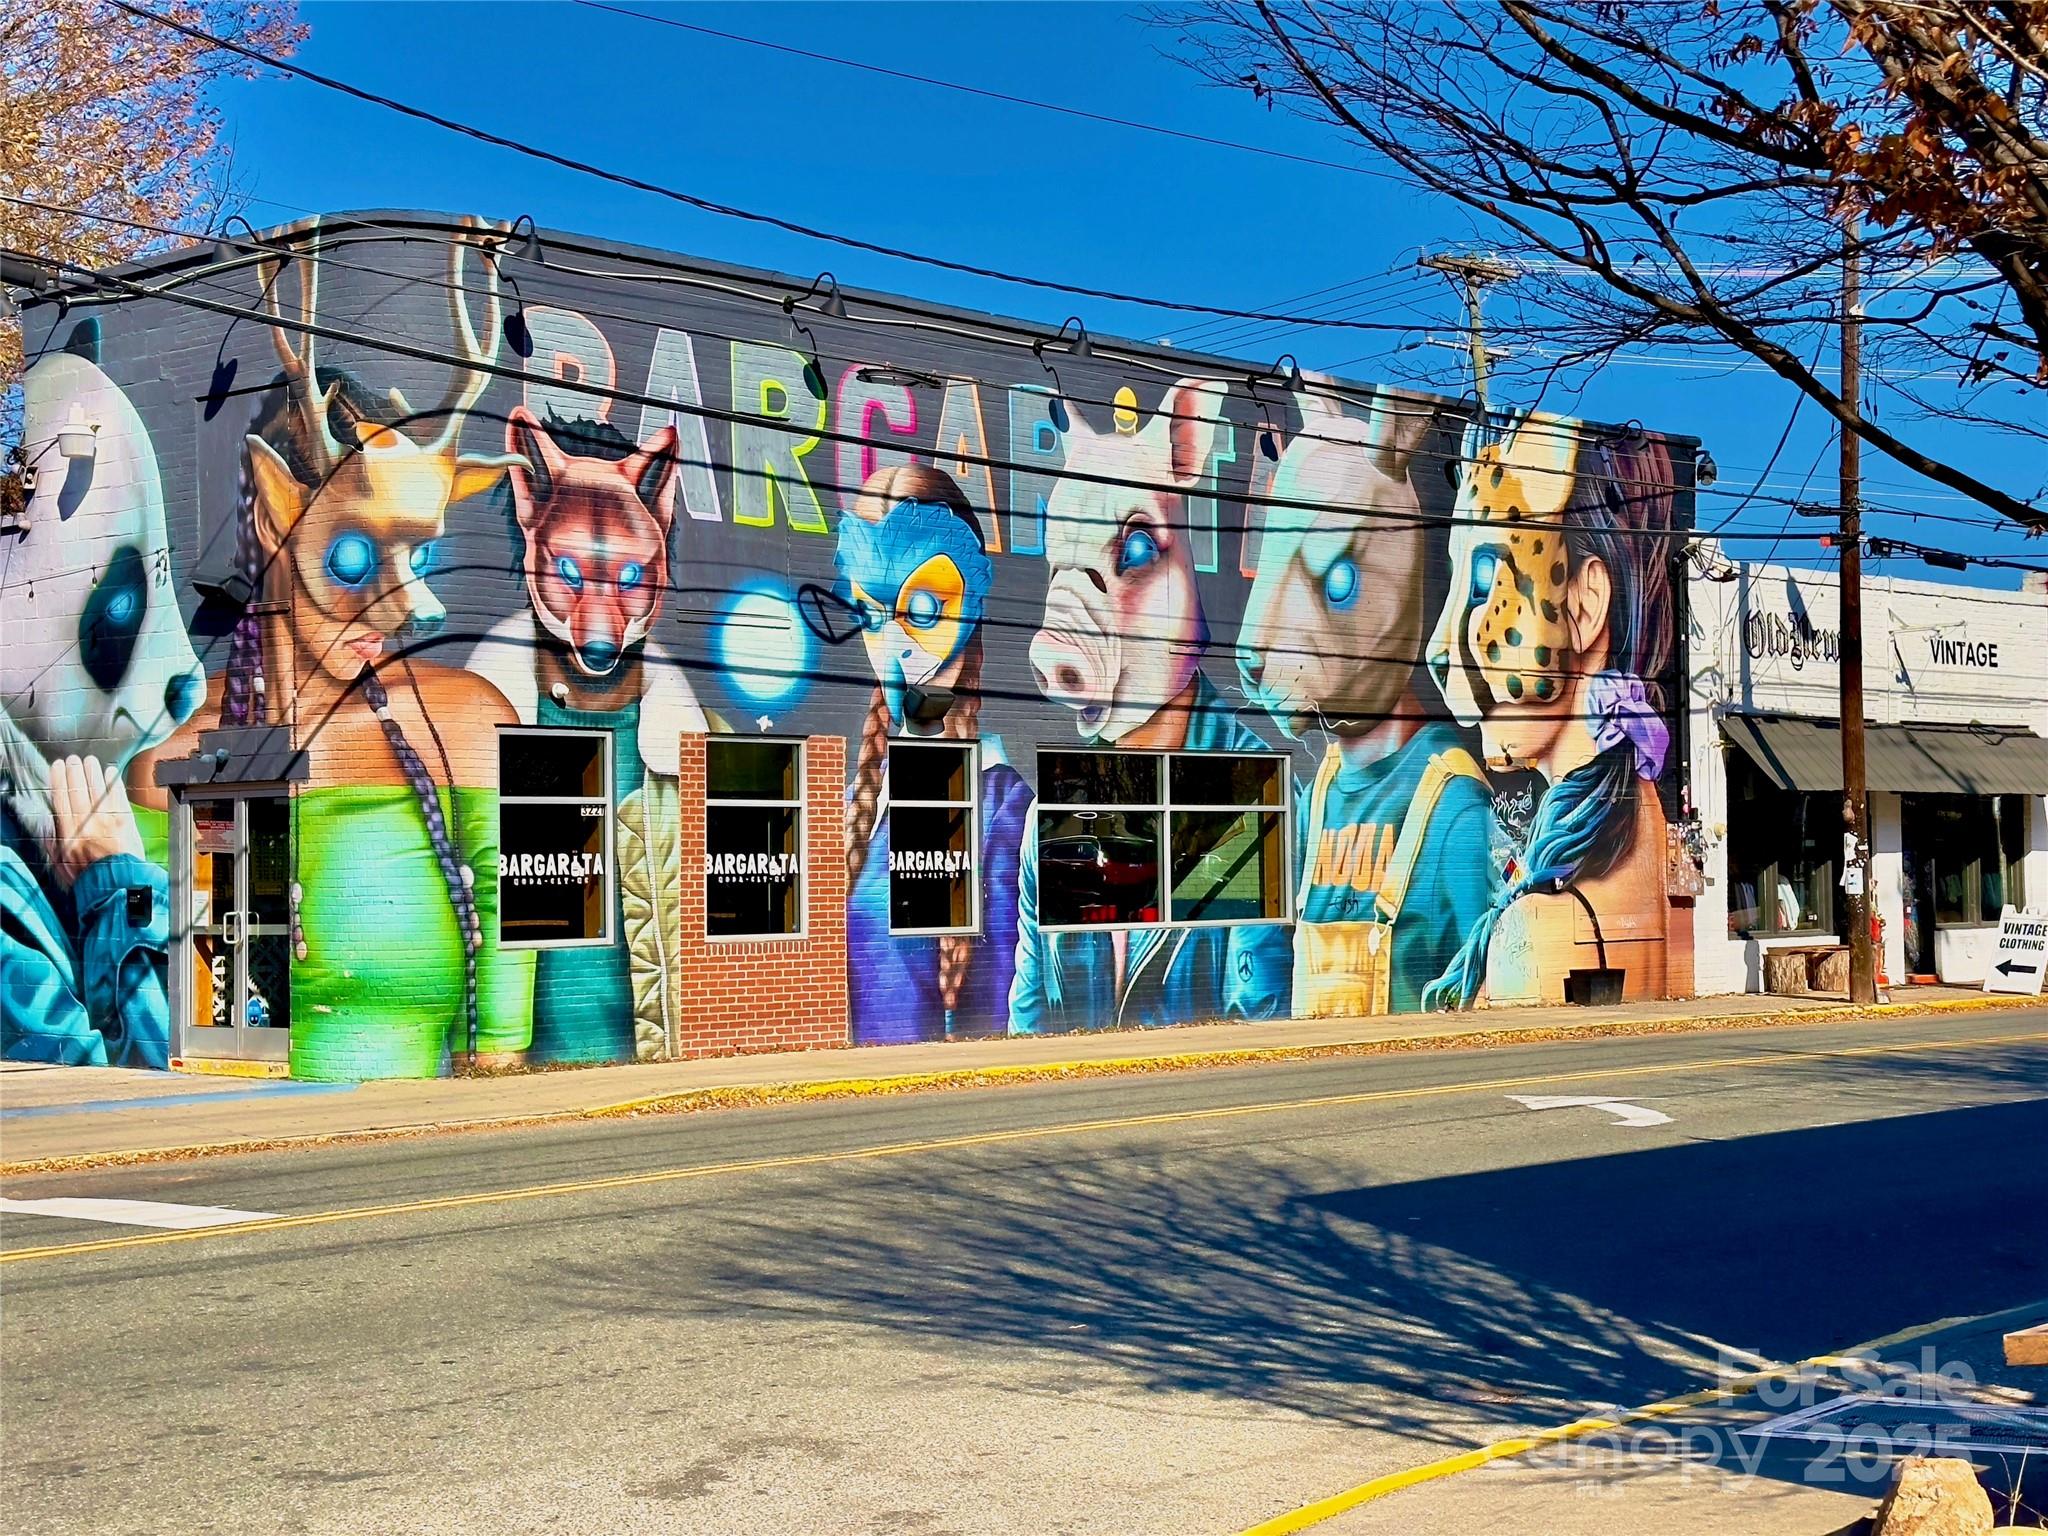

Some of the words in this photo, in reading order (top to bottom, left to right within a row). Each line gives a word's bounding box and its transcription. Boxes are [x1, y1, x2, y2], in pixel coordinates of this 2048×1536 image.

[1931, 638, 1999, 668] VINTAGE
[2004, 922, 2048, 937] VINTAGE
[1999, 937, 2045, 951] CLOTHING
